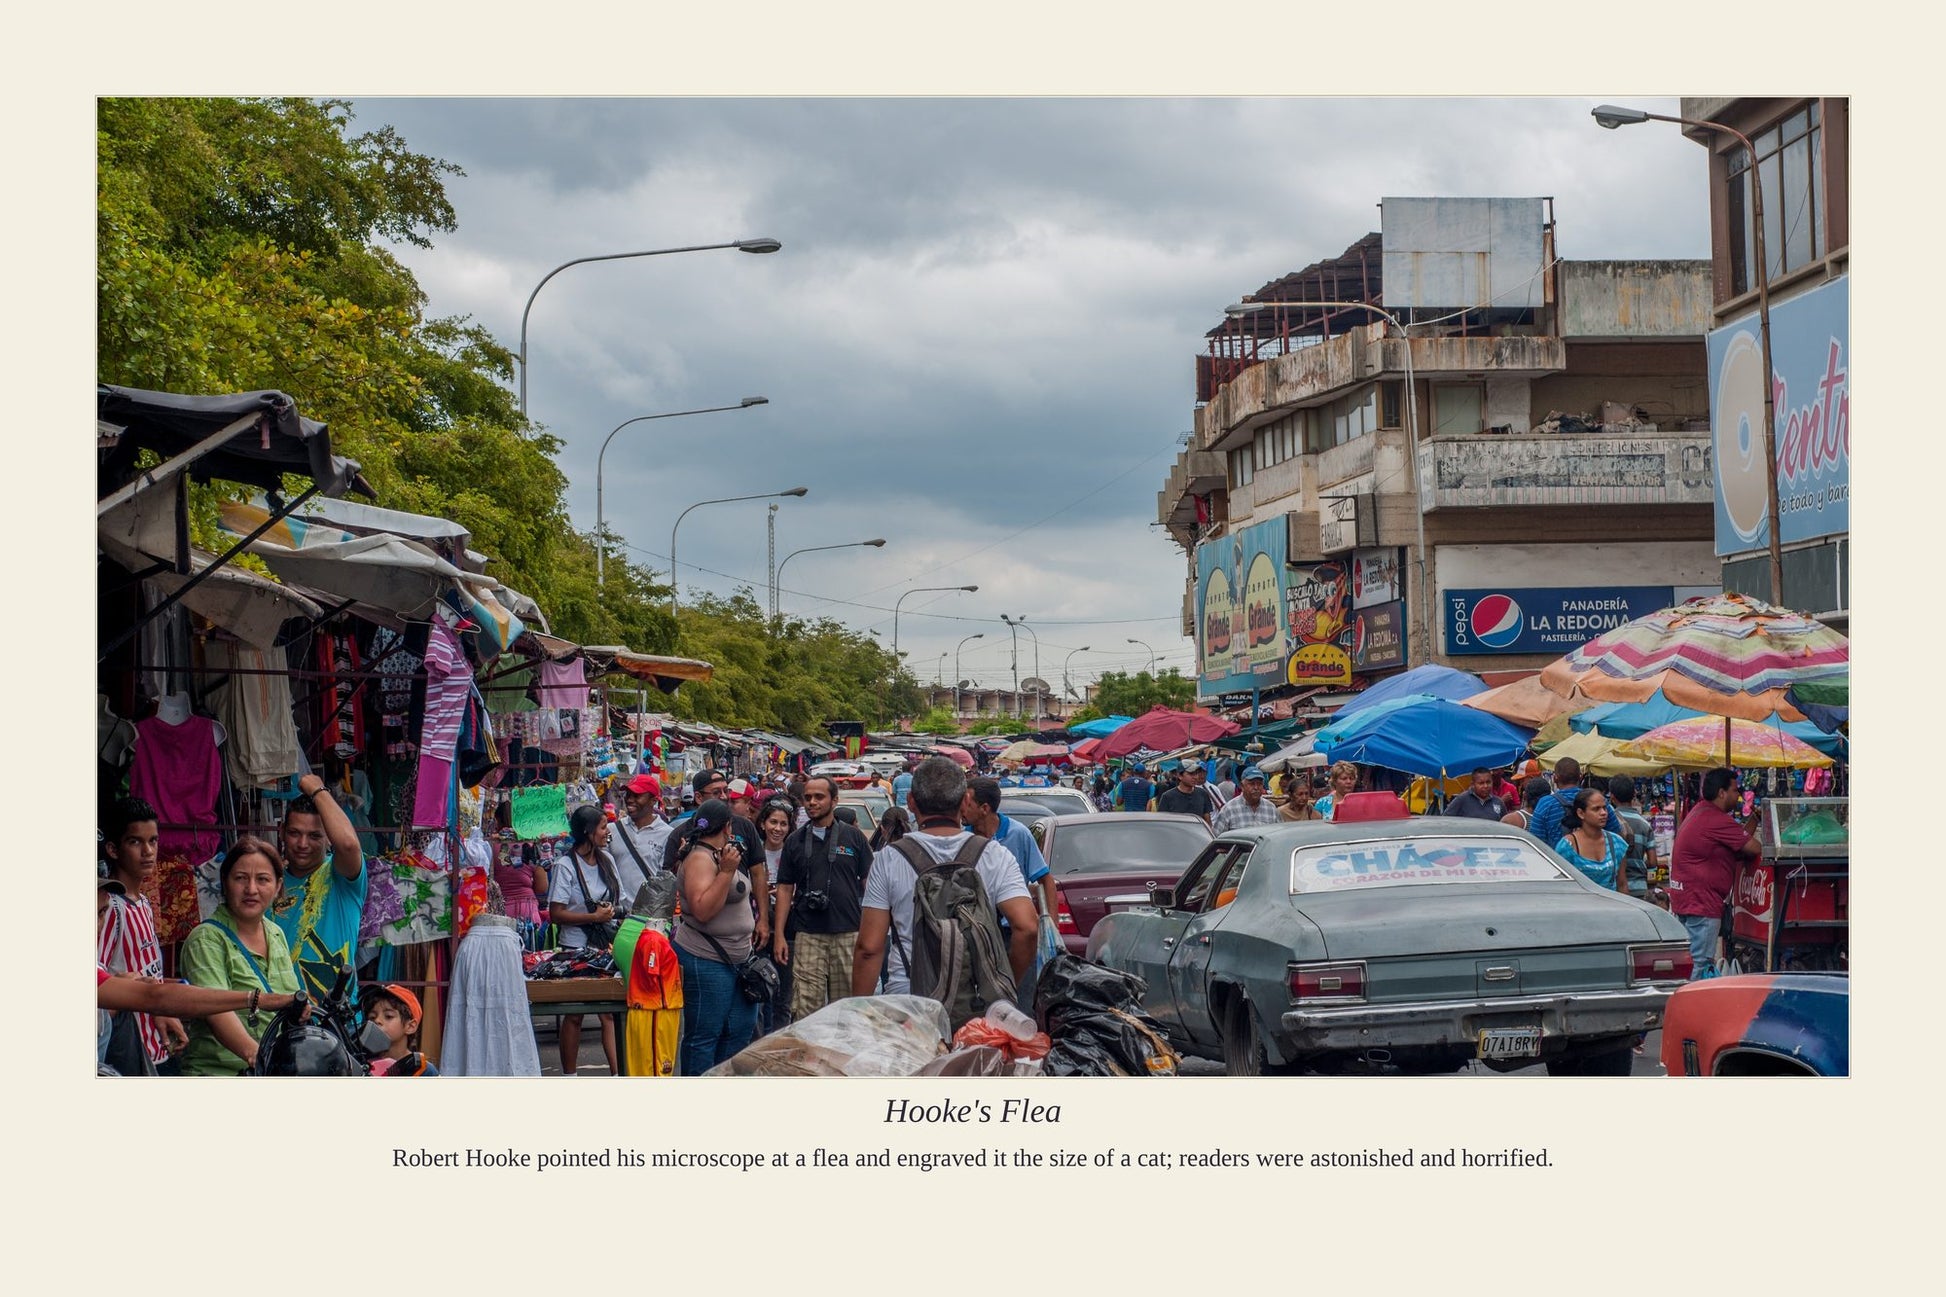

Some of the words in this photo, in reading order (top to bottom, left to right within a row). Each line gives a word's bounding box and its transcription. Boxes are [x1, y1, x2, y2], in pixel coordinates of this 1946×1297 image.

[1789, 487, 1814, 512] todo
[1817, 490, 1824, 511] y
[1562, 597, 1629, 611] PANADERÍA
[1248, 598, 1277, 631] Grande
[1452, 598, 1469, 645] pepsi
[1531, 616, 1551, 630] LA
[1557, 614, 1629, 629] REDOMA
[1206, 610, 1230, 640] Grande
[1541, 632, 1586, 642] PASTELERÍA
[1296, 660, 1344, 673] Grande
[1420, 867, 1442, 877] DE
[1446, 868, 1465, 877] MI
[1469, 867, 1529, 877] PATRIA
